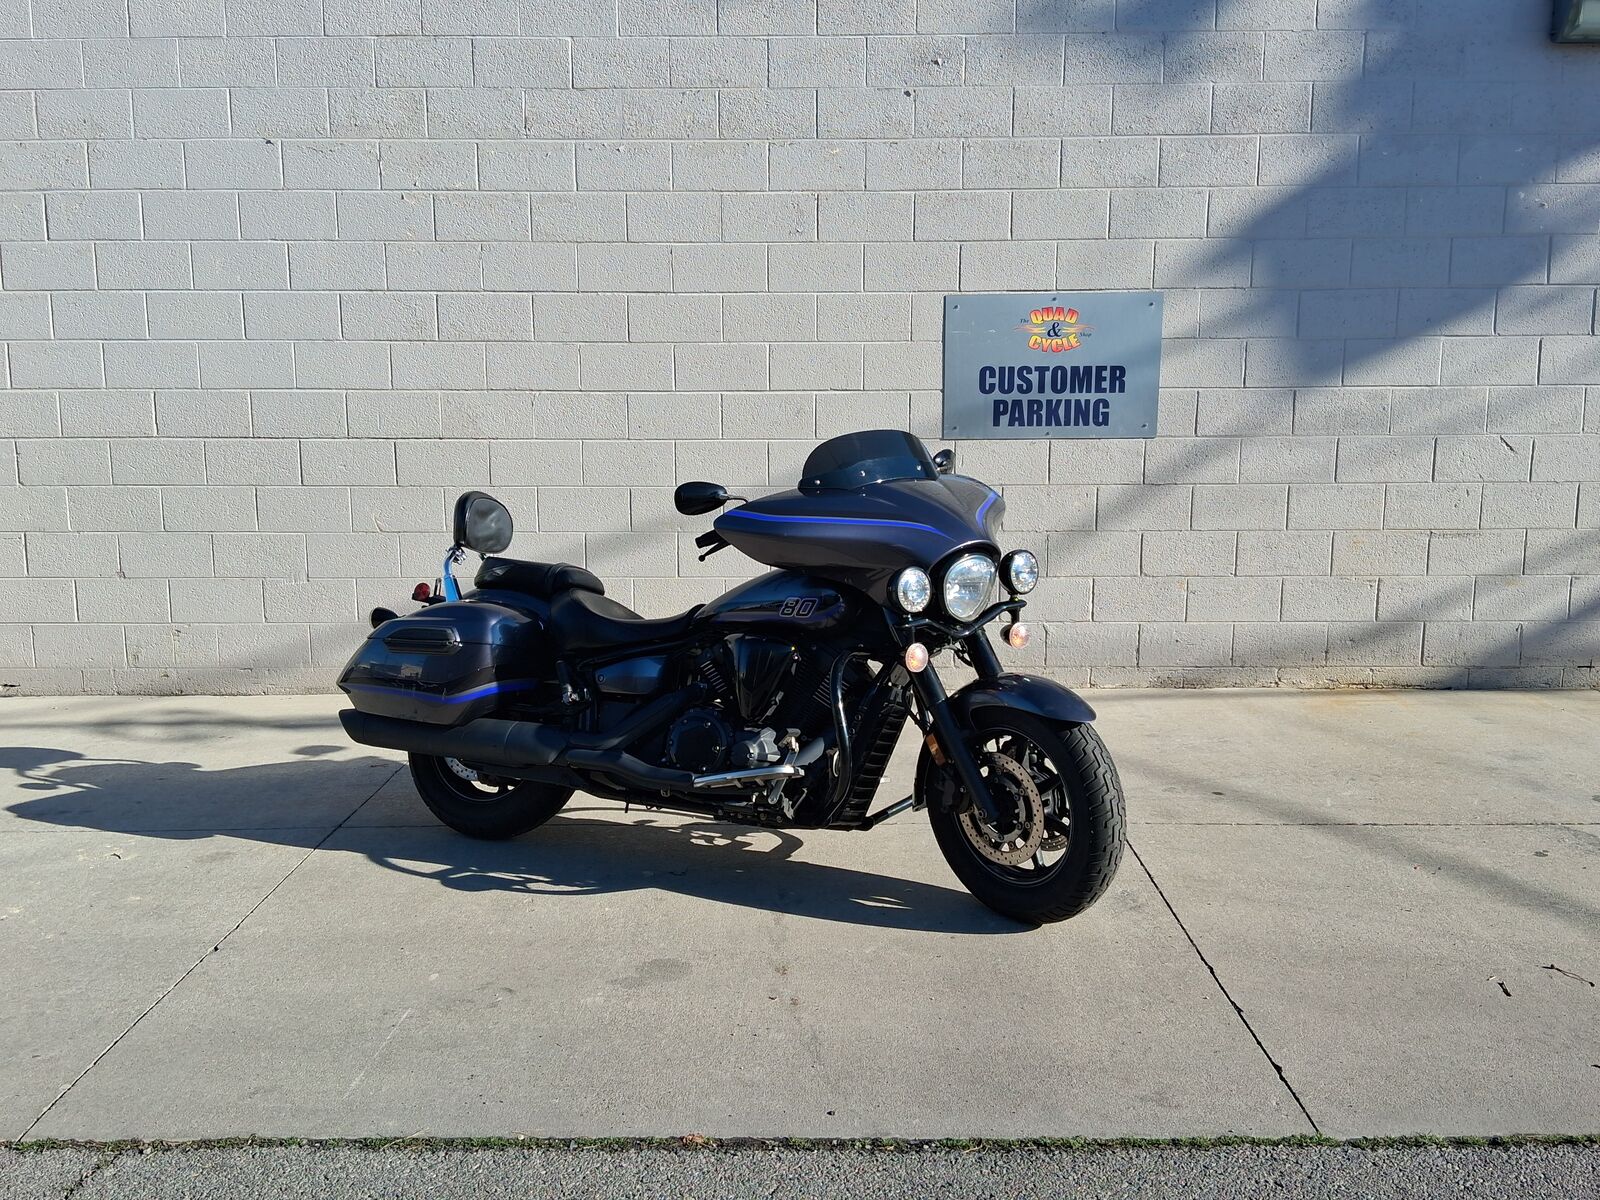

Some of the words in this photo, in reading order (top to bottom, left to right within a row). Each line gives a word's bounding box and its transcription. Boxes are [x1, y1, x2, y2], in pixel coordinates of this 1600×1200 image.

[1030, 307, 1079, 324] QUAD
[1047, 322, 1061, 337] &
[1028, 333, 1081, 352] CYCLE
[979, 365, 1126, 394] CUSTOMER
[993, 398, 1110, 427] PARKING
[780, 597, 818, 618] 80
